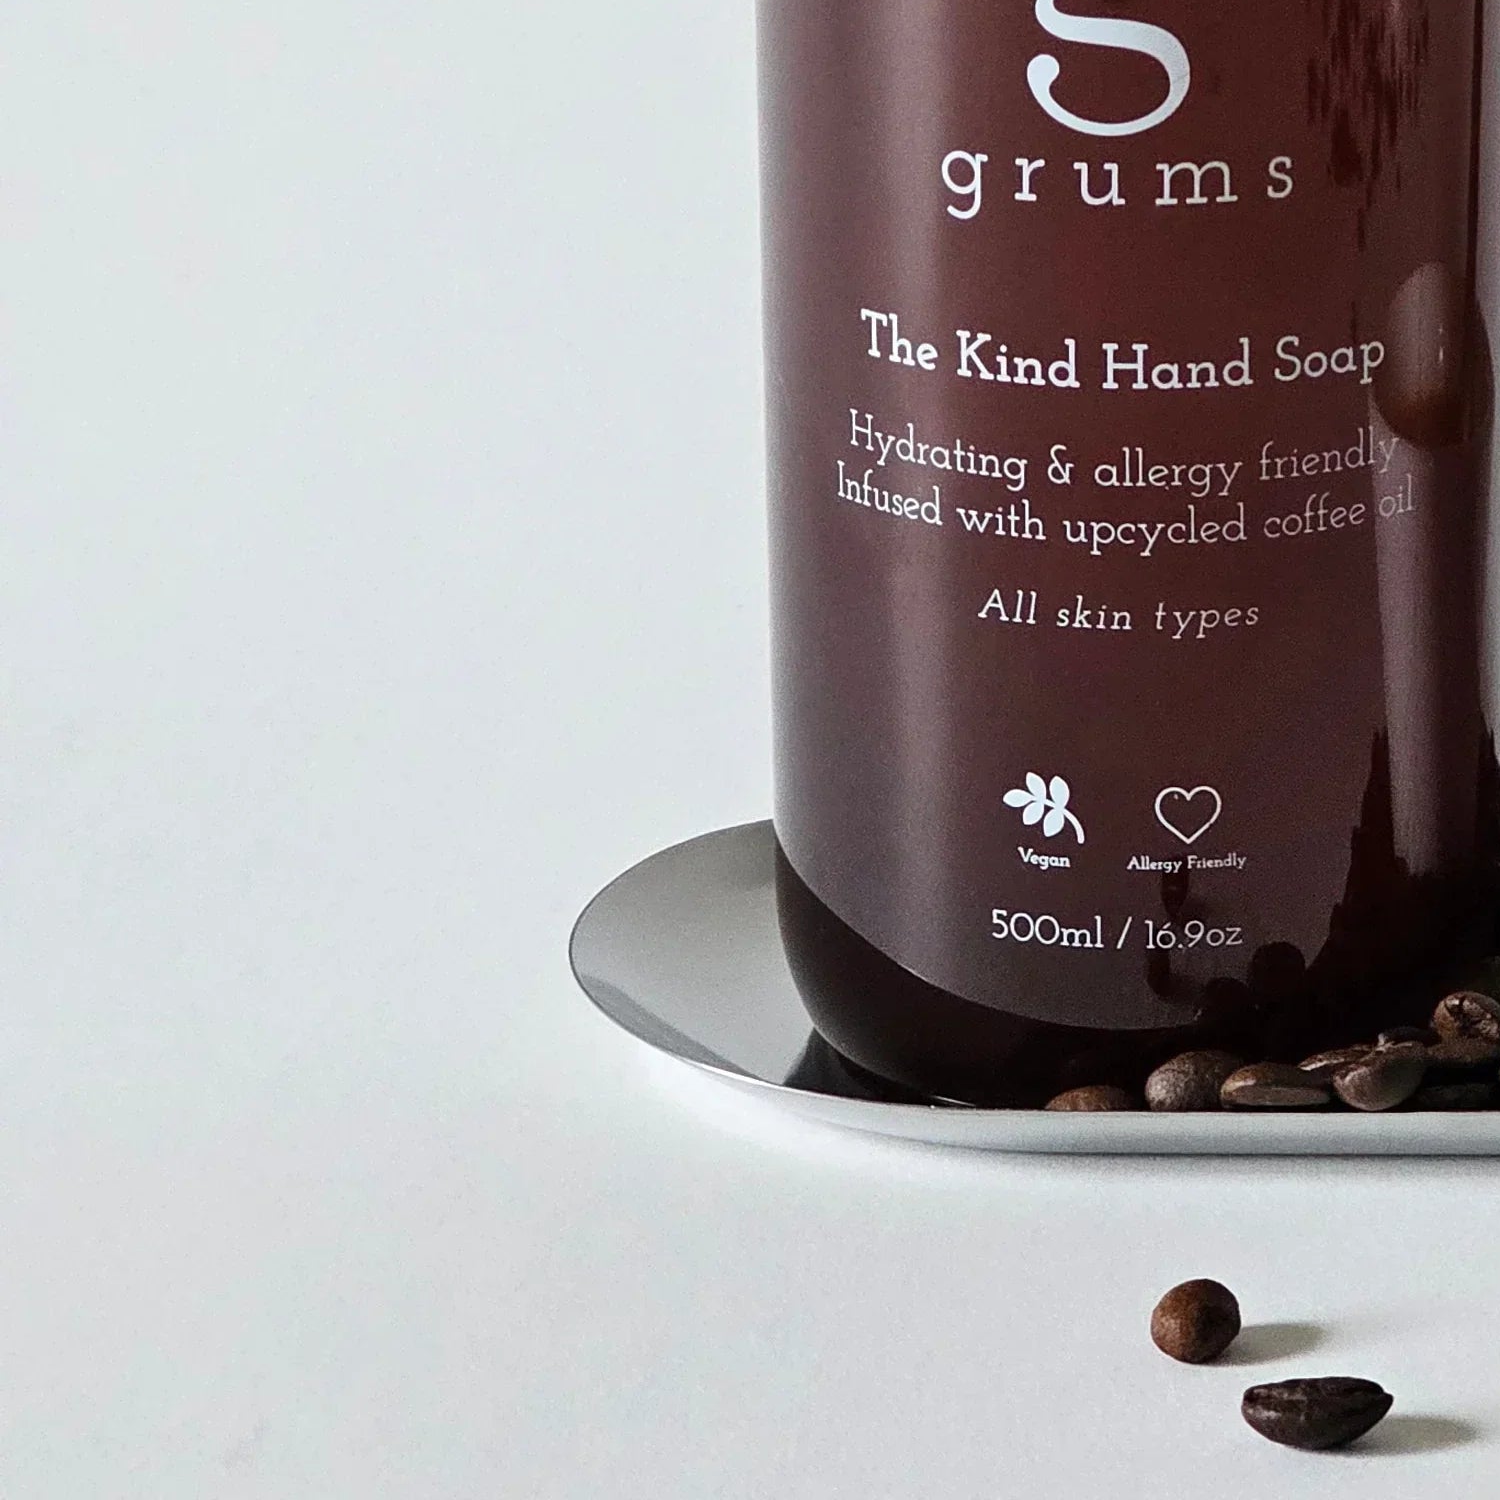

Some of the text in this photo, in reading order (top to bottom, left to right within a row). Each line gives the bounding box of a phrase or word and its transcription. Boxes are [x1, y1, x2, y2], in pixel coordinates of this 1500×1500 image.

[940, 149, 1294, 220] grums
[860, 308, 1386, 389] The Kind Hand Soap
[849, 408, 1400, 497] Hydrating & allergy friendly
[836, 461, 1417, 556] Infused with upcycled coffee oil
[977, 588, 1260, 639] All skin types
[1017, 846, 1071, 871] Vegan
[1126, 852, 1247, 873] Allergy Friendly
[991, 909, 1244, 950] 500ml / 16.9oz
